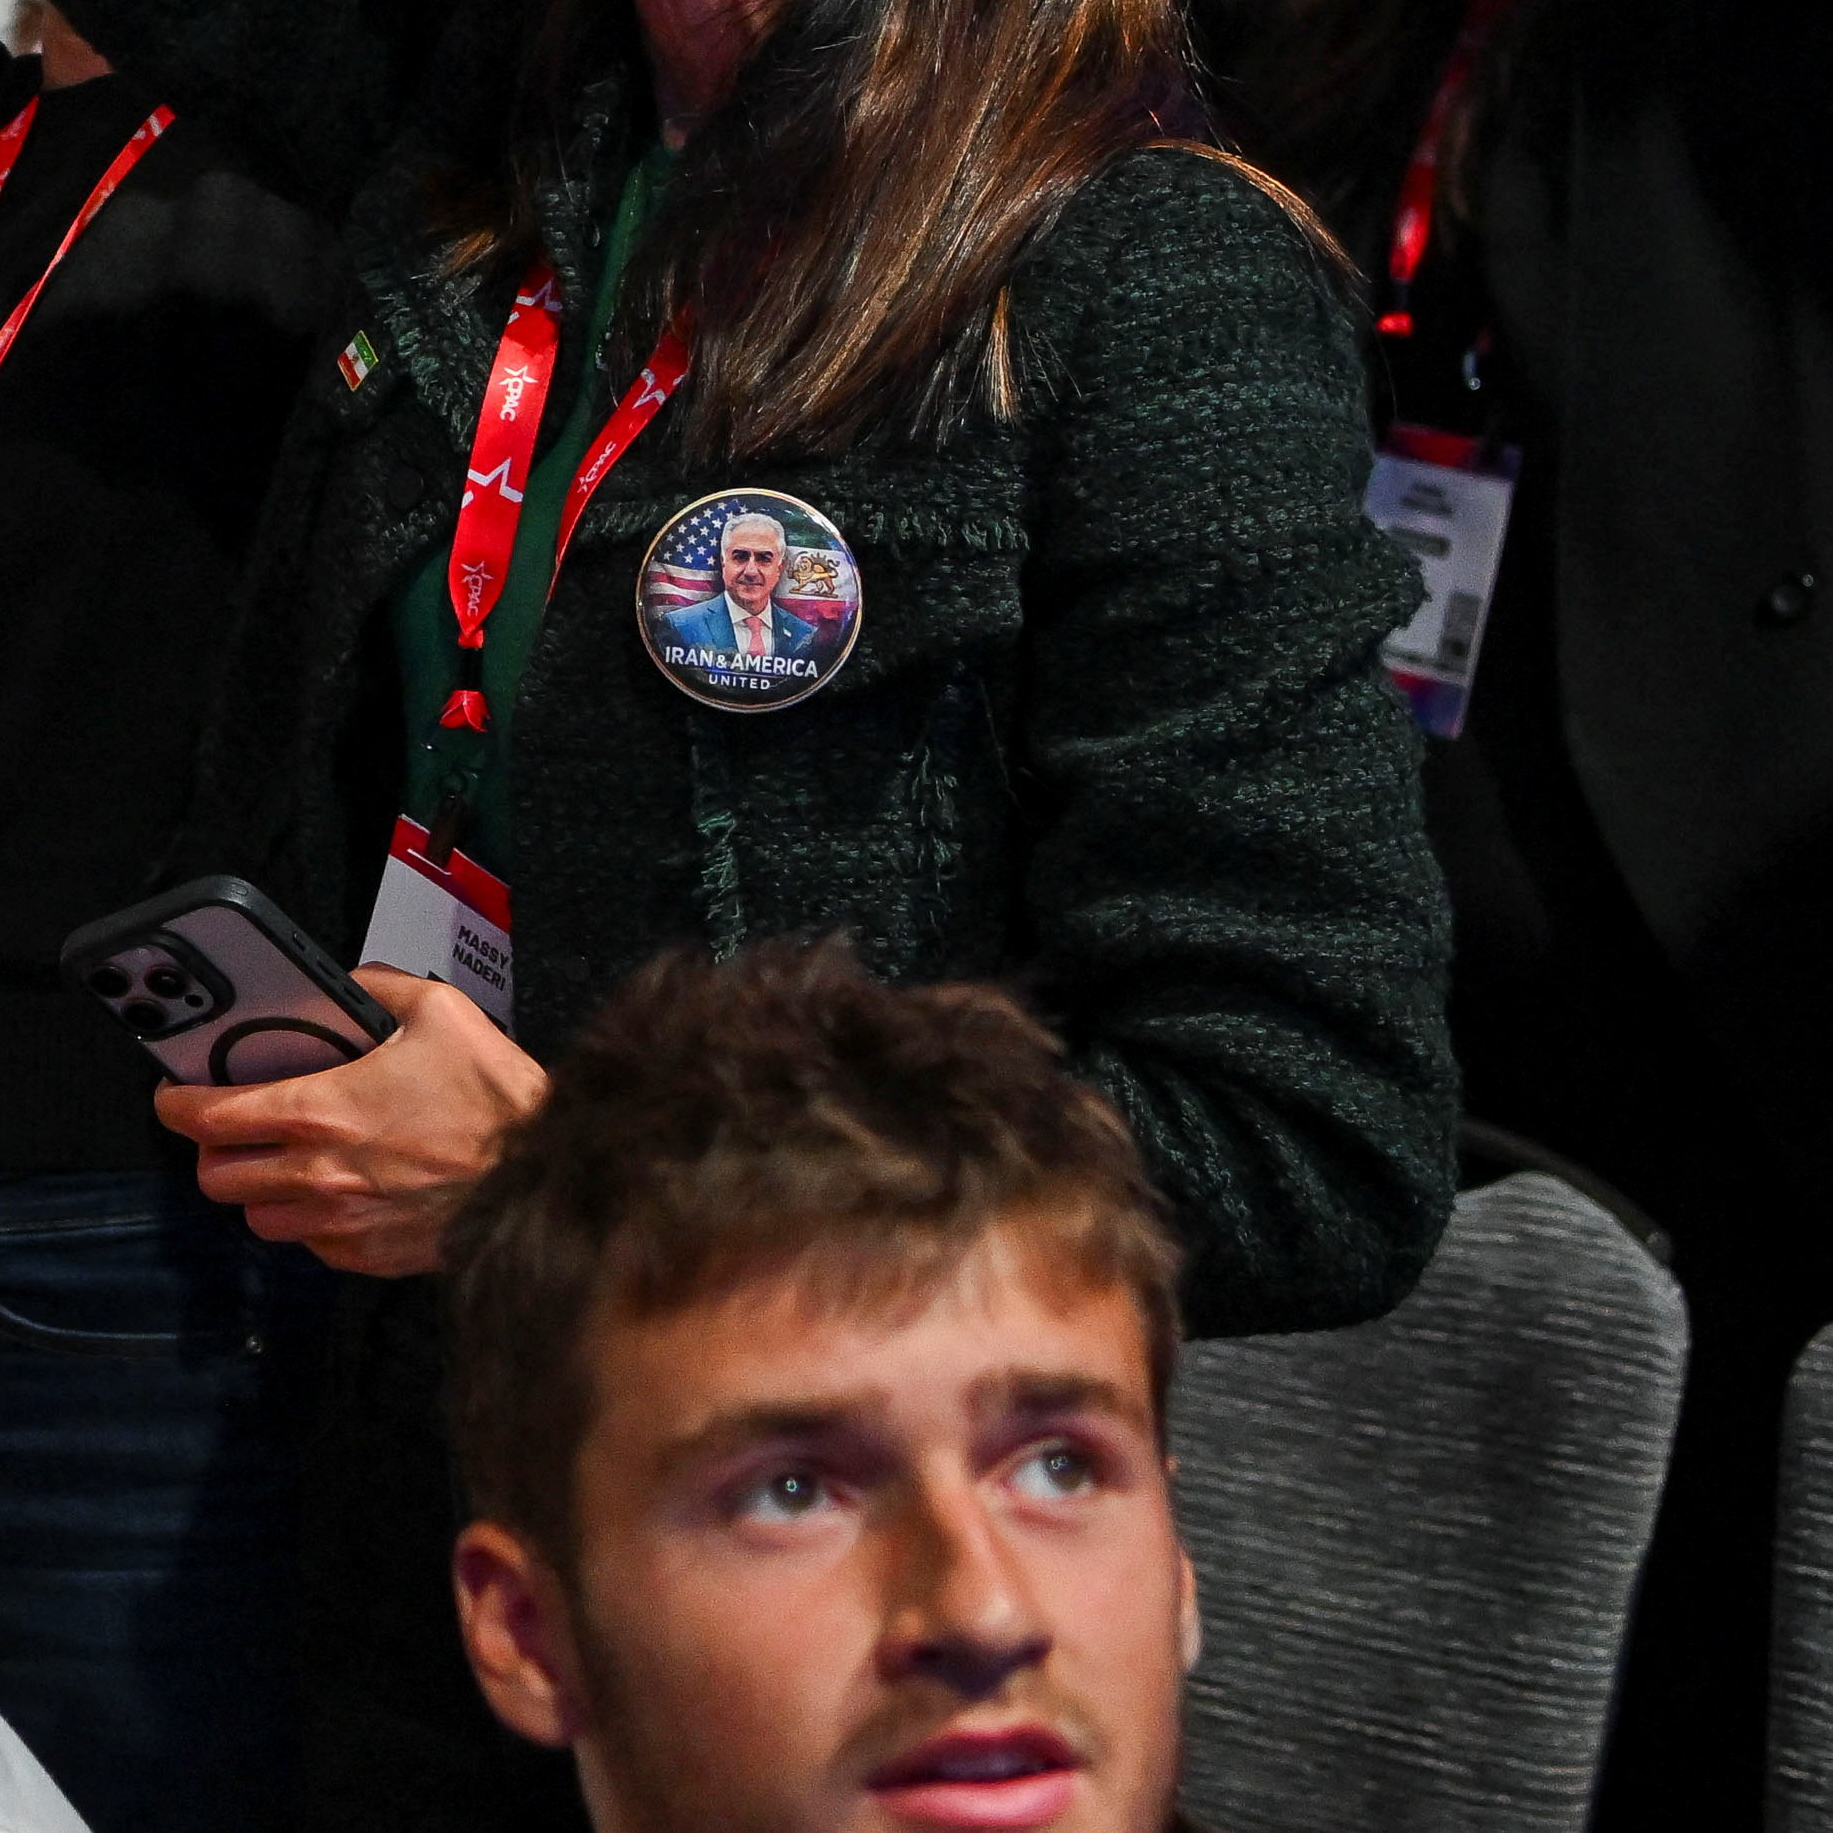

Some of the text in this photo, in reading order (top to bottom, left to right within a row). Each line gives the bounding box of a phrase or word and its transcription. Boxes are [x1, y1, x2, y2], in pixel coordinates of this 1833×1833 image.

[499, 373, 530, 422] CPAC
[584, 441, 616, 484] CPAC
[465, 571, 486, 617] CPAC
[664, 645, 819, 679] IRAN & AMERICA
[708, 674, 771, 691] UNITED
[452, 944, 506, 992] NADERI
[457, 925, 510, 970] MASSY
